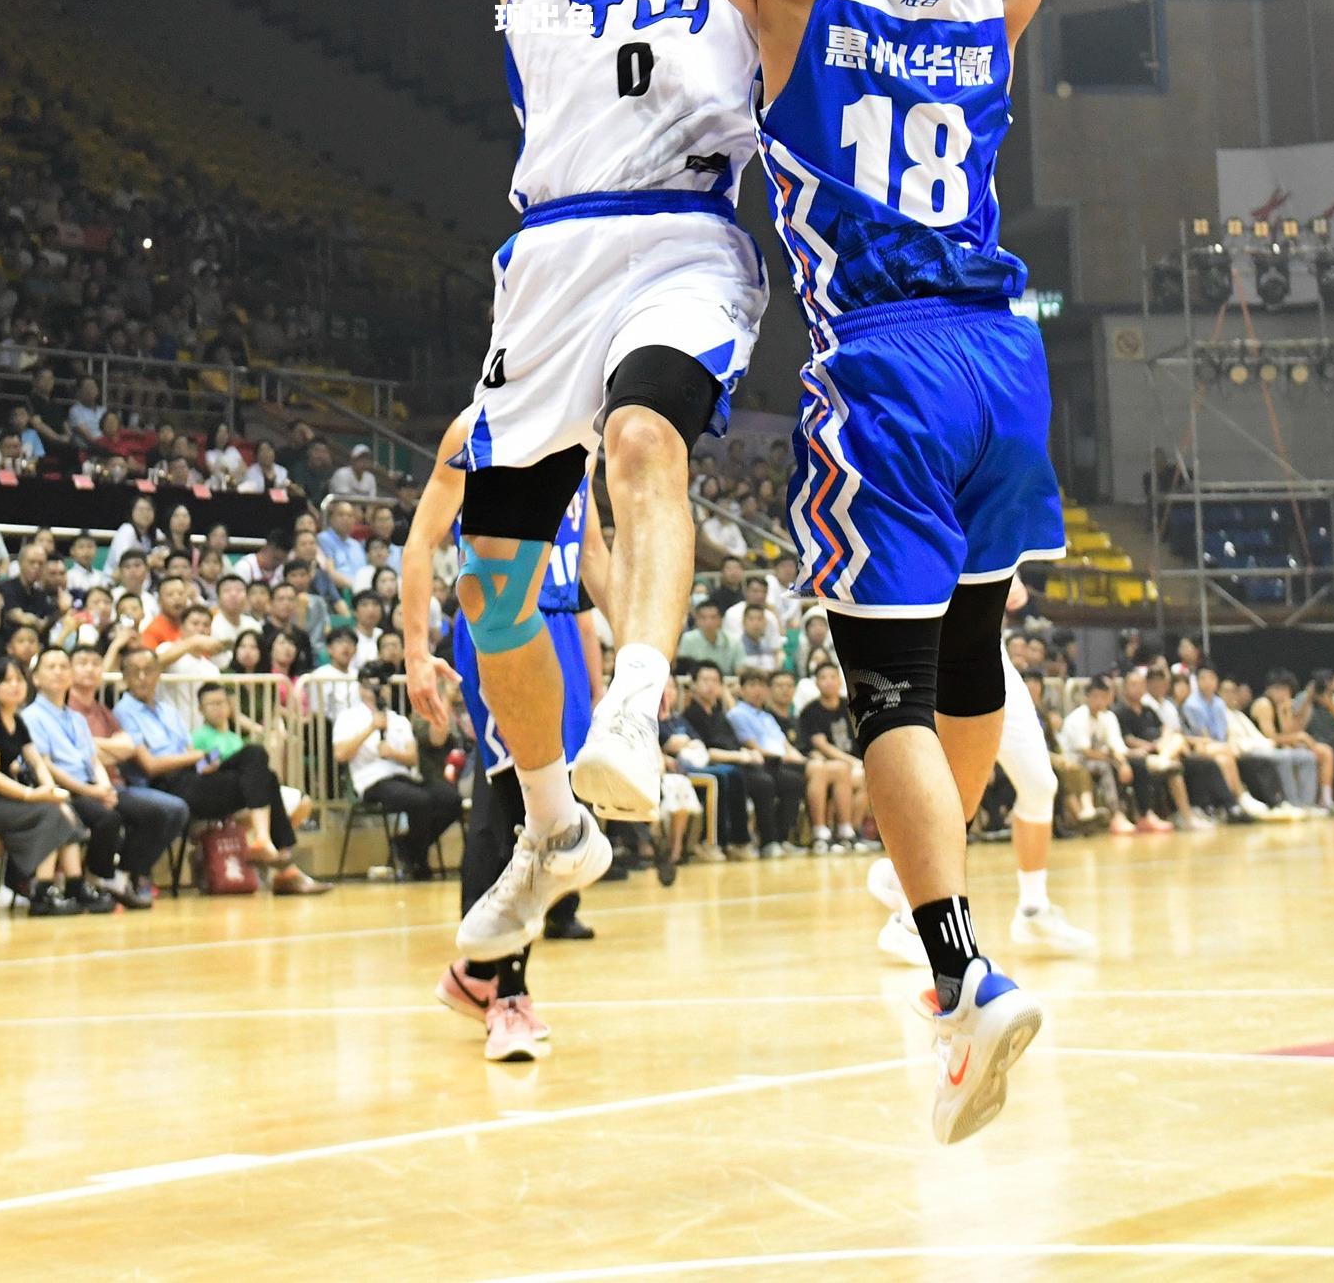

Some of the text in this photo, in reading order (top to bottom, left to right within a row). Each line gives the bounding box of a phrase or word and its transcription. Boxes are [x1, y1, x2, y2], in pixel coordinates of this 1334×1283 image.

[618, 41, 654, 98] 0
[824, 25, 995, 88] 惠州华灏
[839, 95, 970, 227] 18
